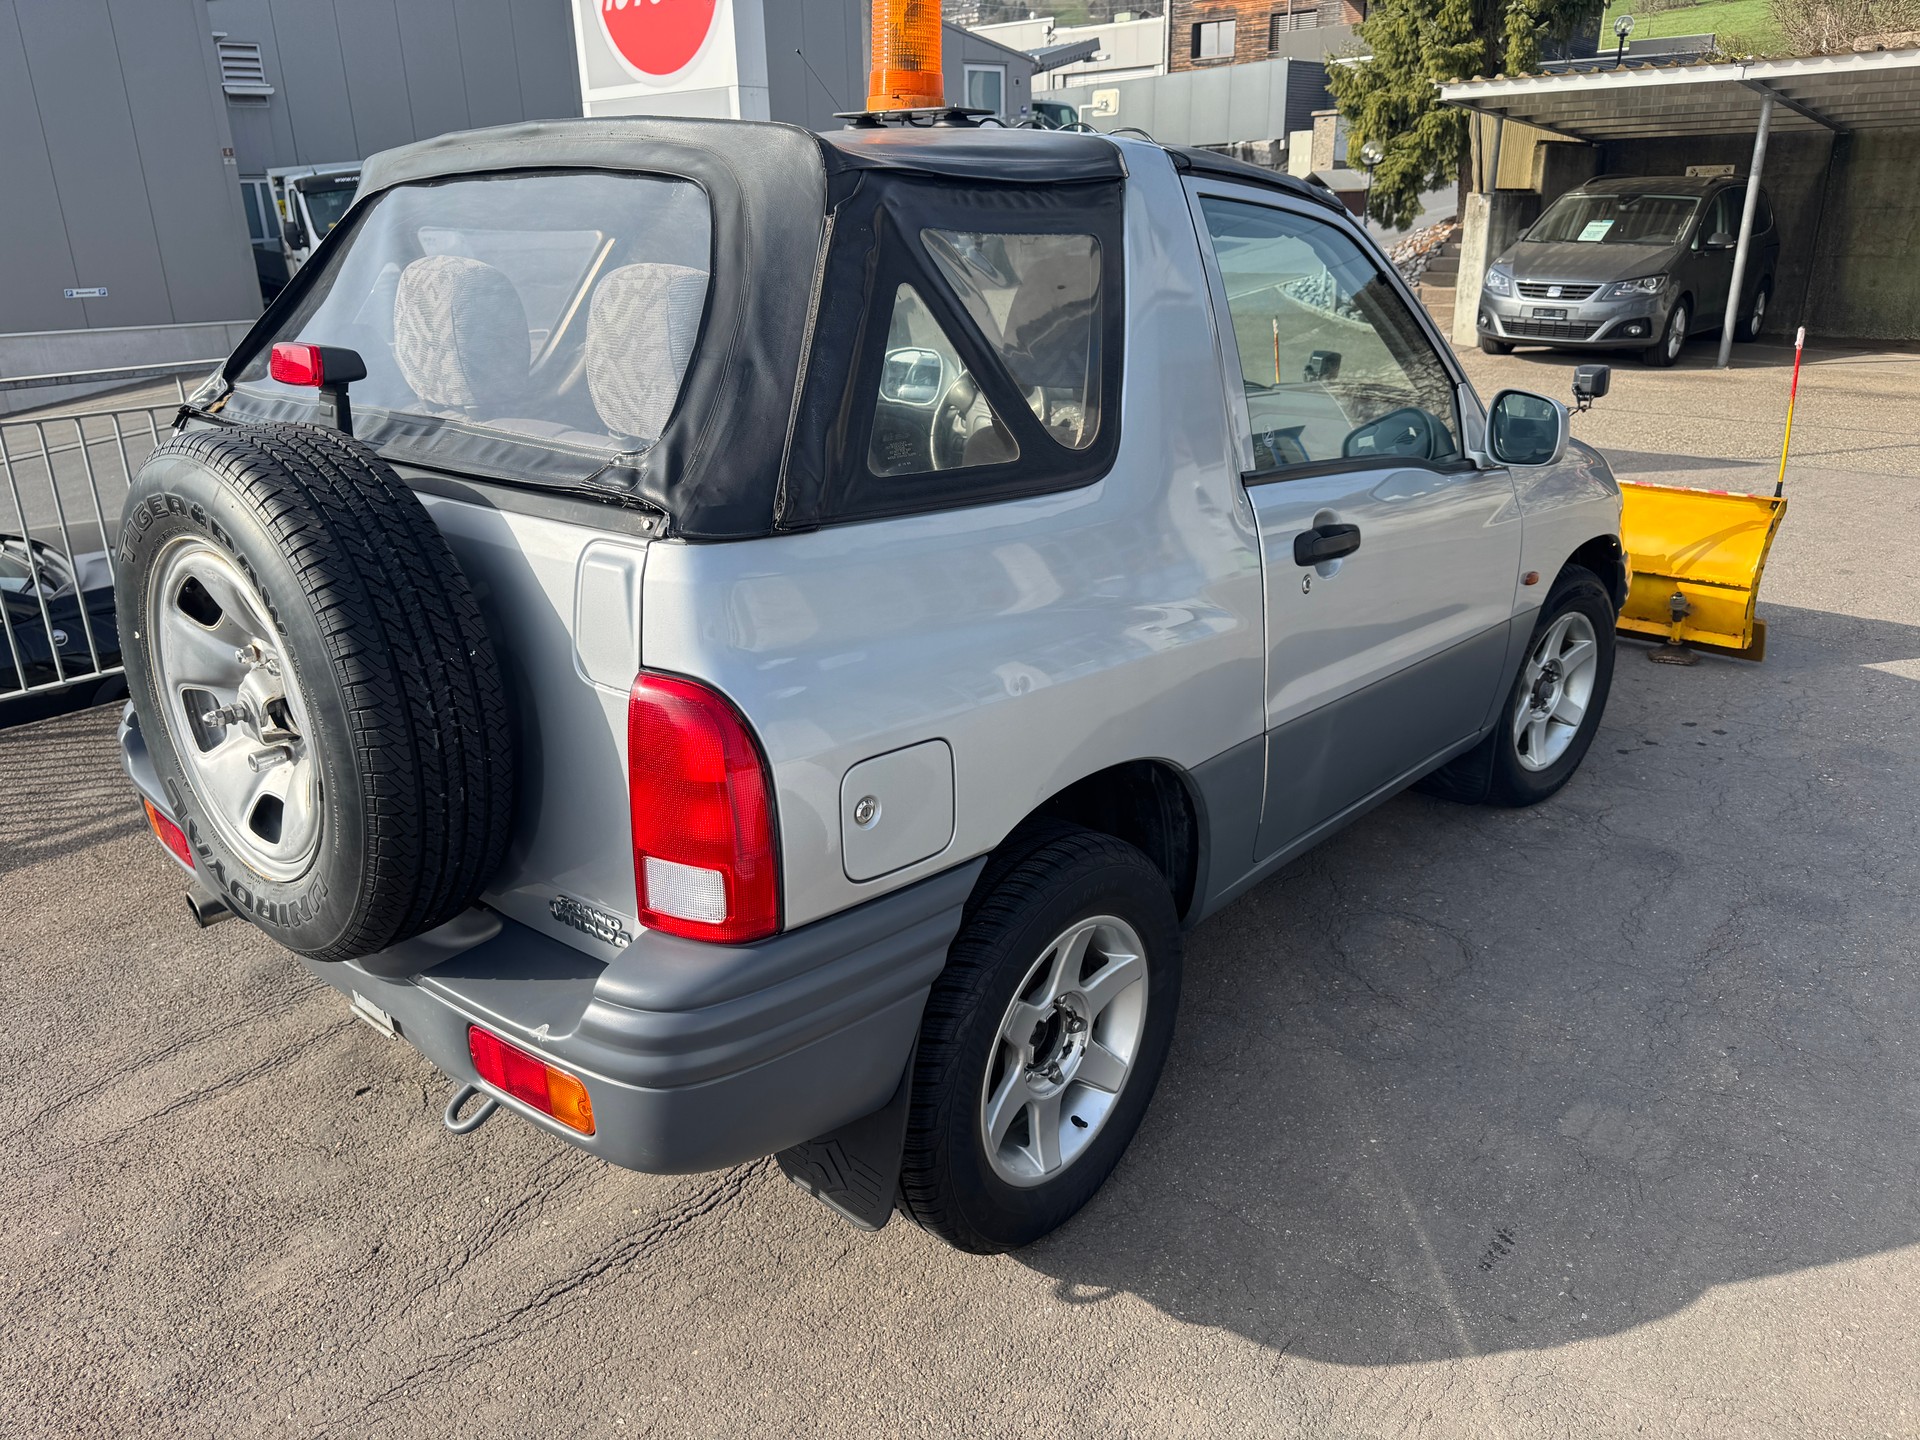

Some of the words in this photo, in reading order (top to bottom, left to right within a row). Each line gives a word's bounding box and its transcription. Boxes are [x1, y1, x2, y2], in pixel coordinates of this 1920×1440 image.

[119, 493, 190, 563] TIGER
[167, 777, 329, 928] UNIROYAL
[549, 899, 633, 948] VITARA
[554, 894, 623, 931] GRAND
